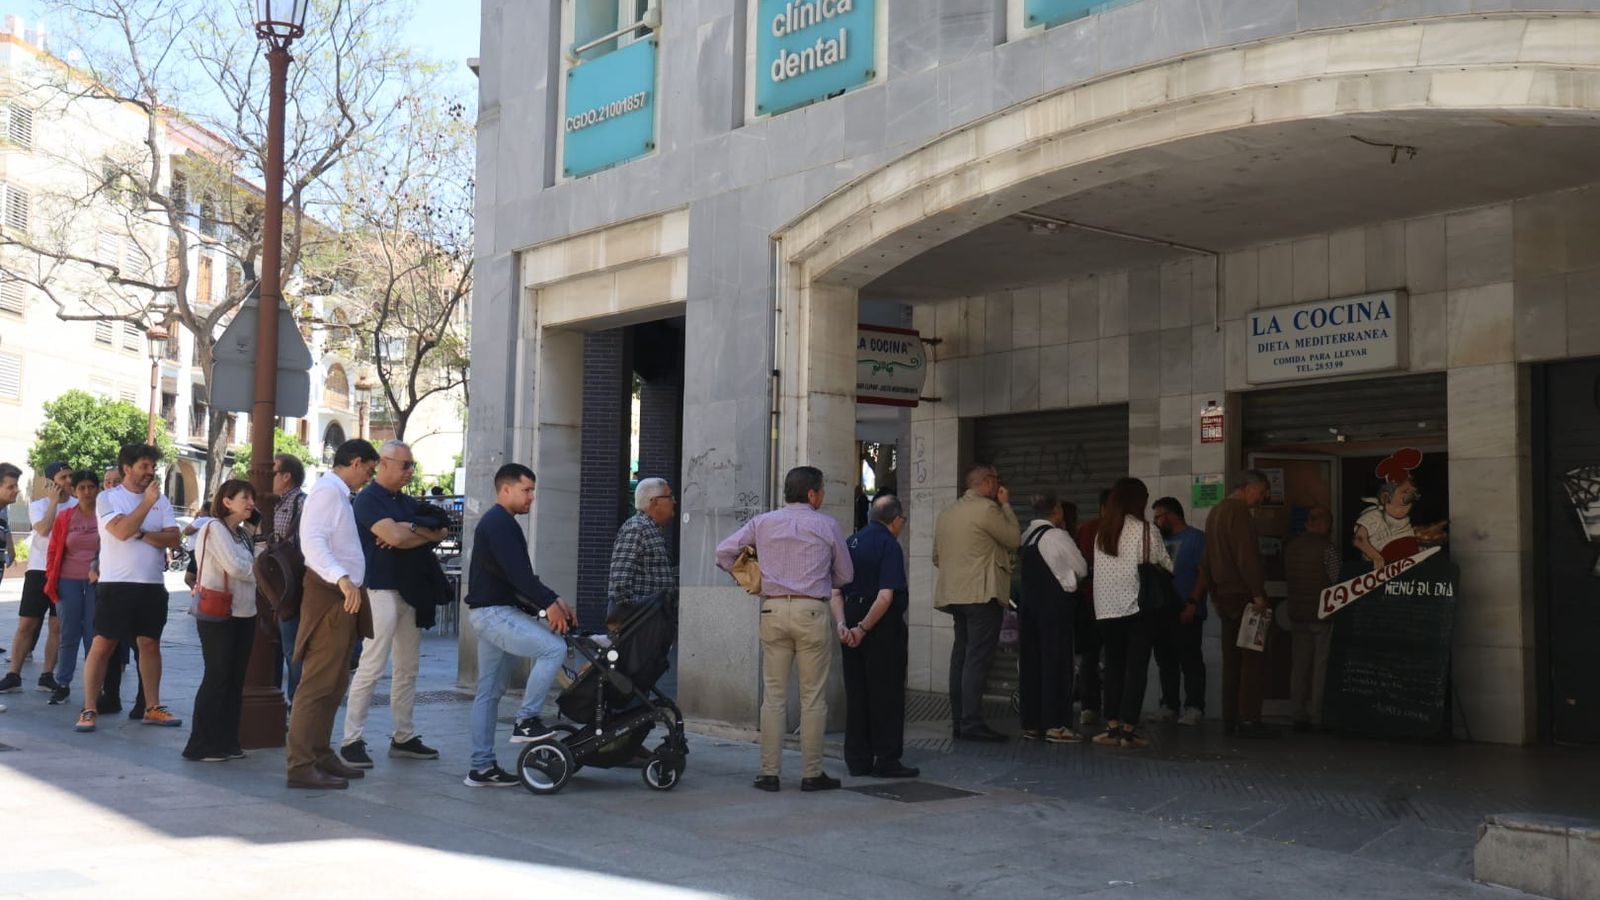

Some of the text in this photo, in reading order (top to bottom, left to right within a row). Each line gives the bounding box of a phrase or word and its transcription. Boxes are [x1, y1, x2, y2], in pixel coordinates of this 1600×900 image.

[771, 0, 853, 37] clínica
[771, 28, 848, 82] dental
[565, 91, 646, 132] CGDO.21001857
[1252, 300, 1392, 336] LA COCINA
[1257, 328, 1389, 353] DIETA MEDITERRANEA
[1273, 348, 1368, 366] COMIDA PARA LLEVAR
[1323, 558, 1416, 613] LA COCINA
